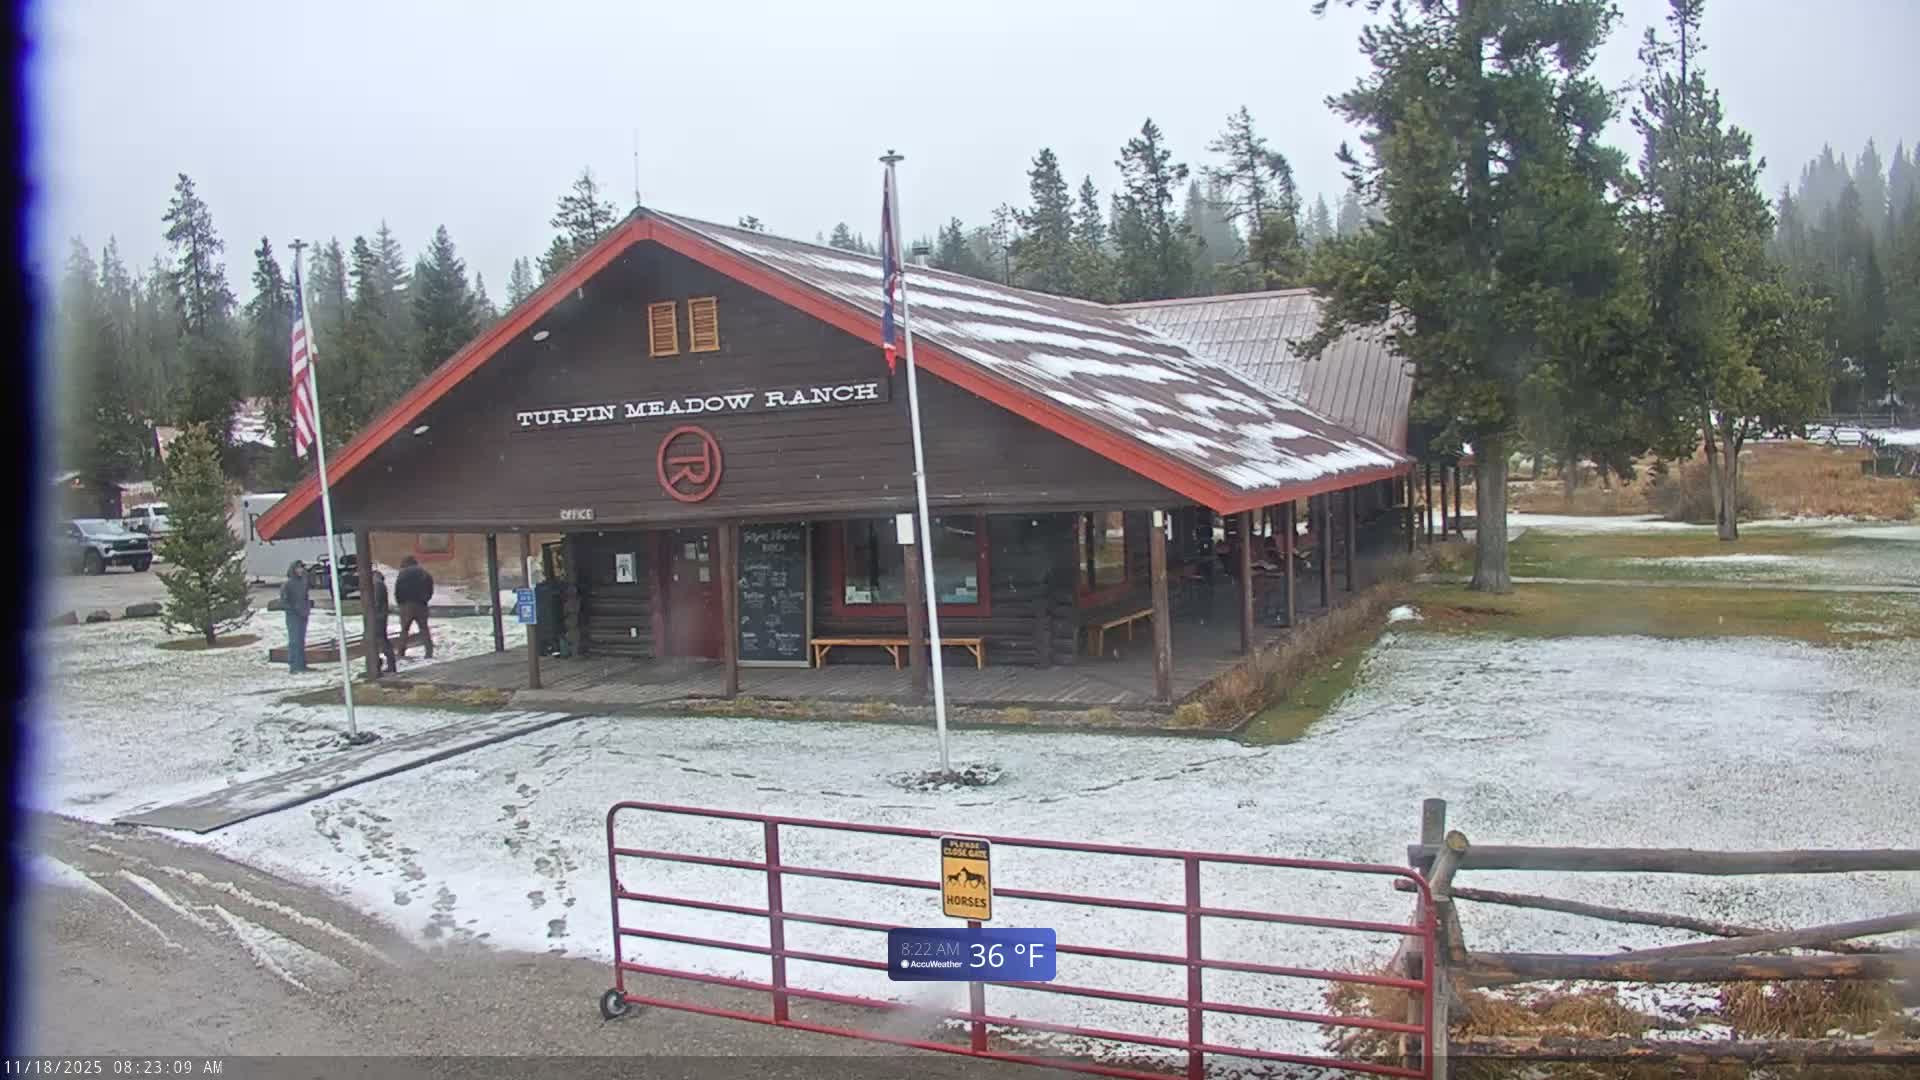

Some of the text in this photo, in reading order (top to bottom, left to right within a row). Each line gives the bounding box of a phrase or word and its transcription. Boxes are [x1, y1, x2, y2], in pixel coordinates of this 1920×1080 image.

[517, 383, 878, 427] TURPIN MEADOW RANCH
[559, 508, 594, 521] OFFICE
[943, 847, 988, 859] CLOSE GATE
[946, 895, 987, 908] HORSES
